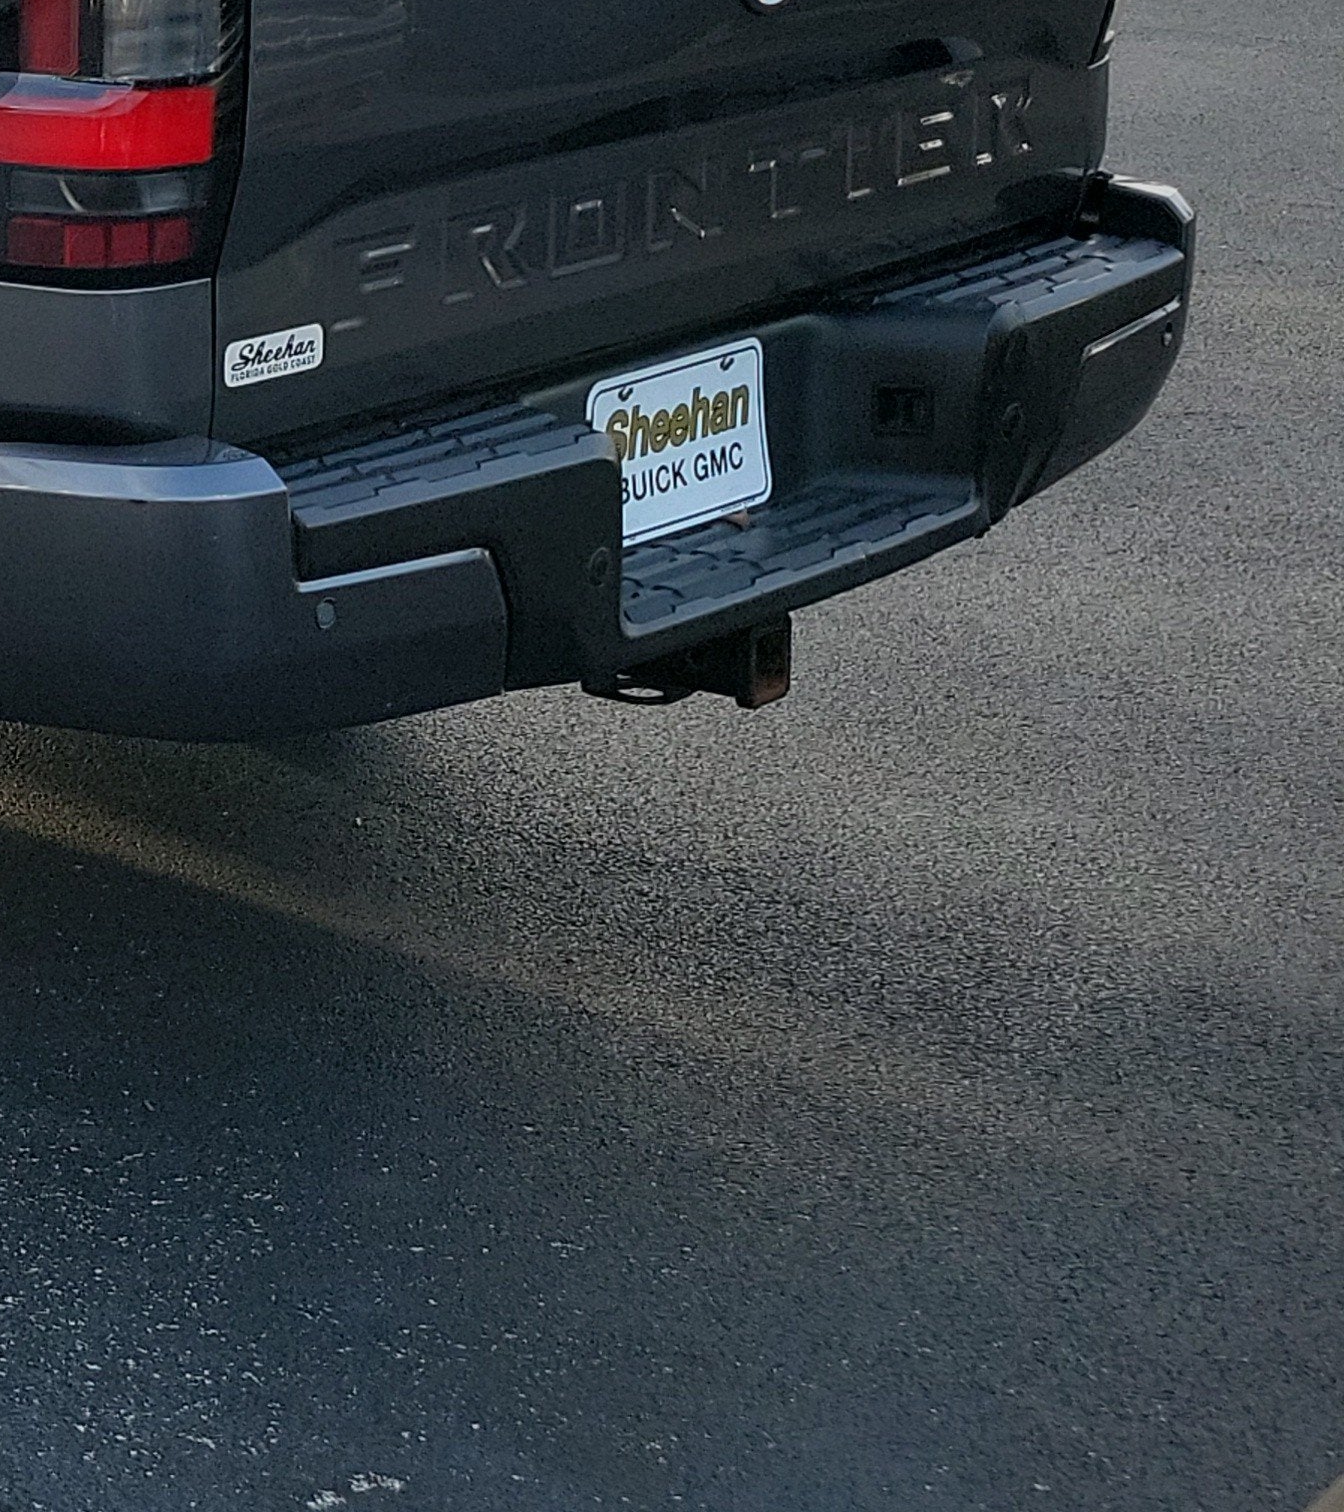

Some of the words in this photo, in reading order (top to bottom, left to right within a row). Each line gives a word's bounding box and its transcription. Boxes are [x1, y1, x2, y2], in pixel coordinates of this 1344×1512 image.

[328, 80, 1033, 332] FRONTIER
[230, 333, 316, 372] Sheehan
[230, 369, 265, 382] FLORIDA
[267, 362, 289, 375] GOLD
[290, 355, 316, 368] COAST
[605, 383, 750, 462] Sheehan
[621, 458, 688, 505] BUICK
[693, 442, 744, 482] GMC
